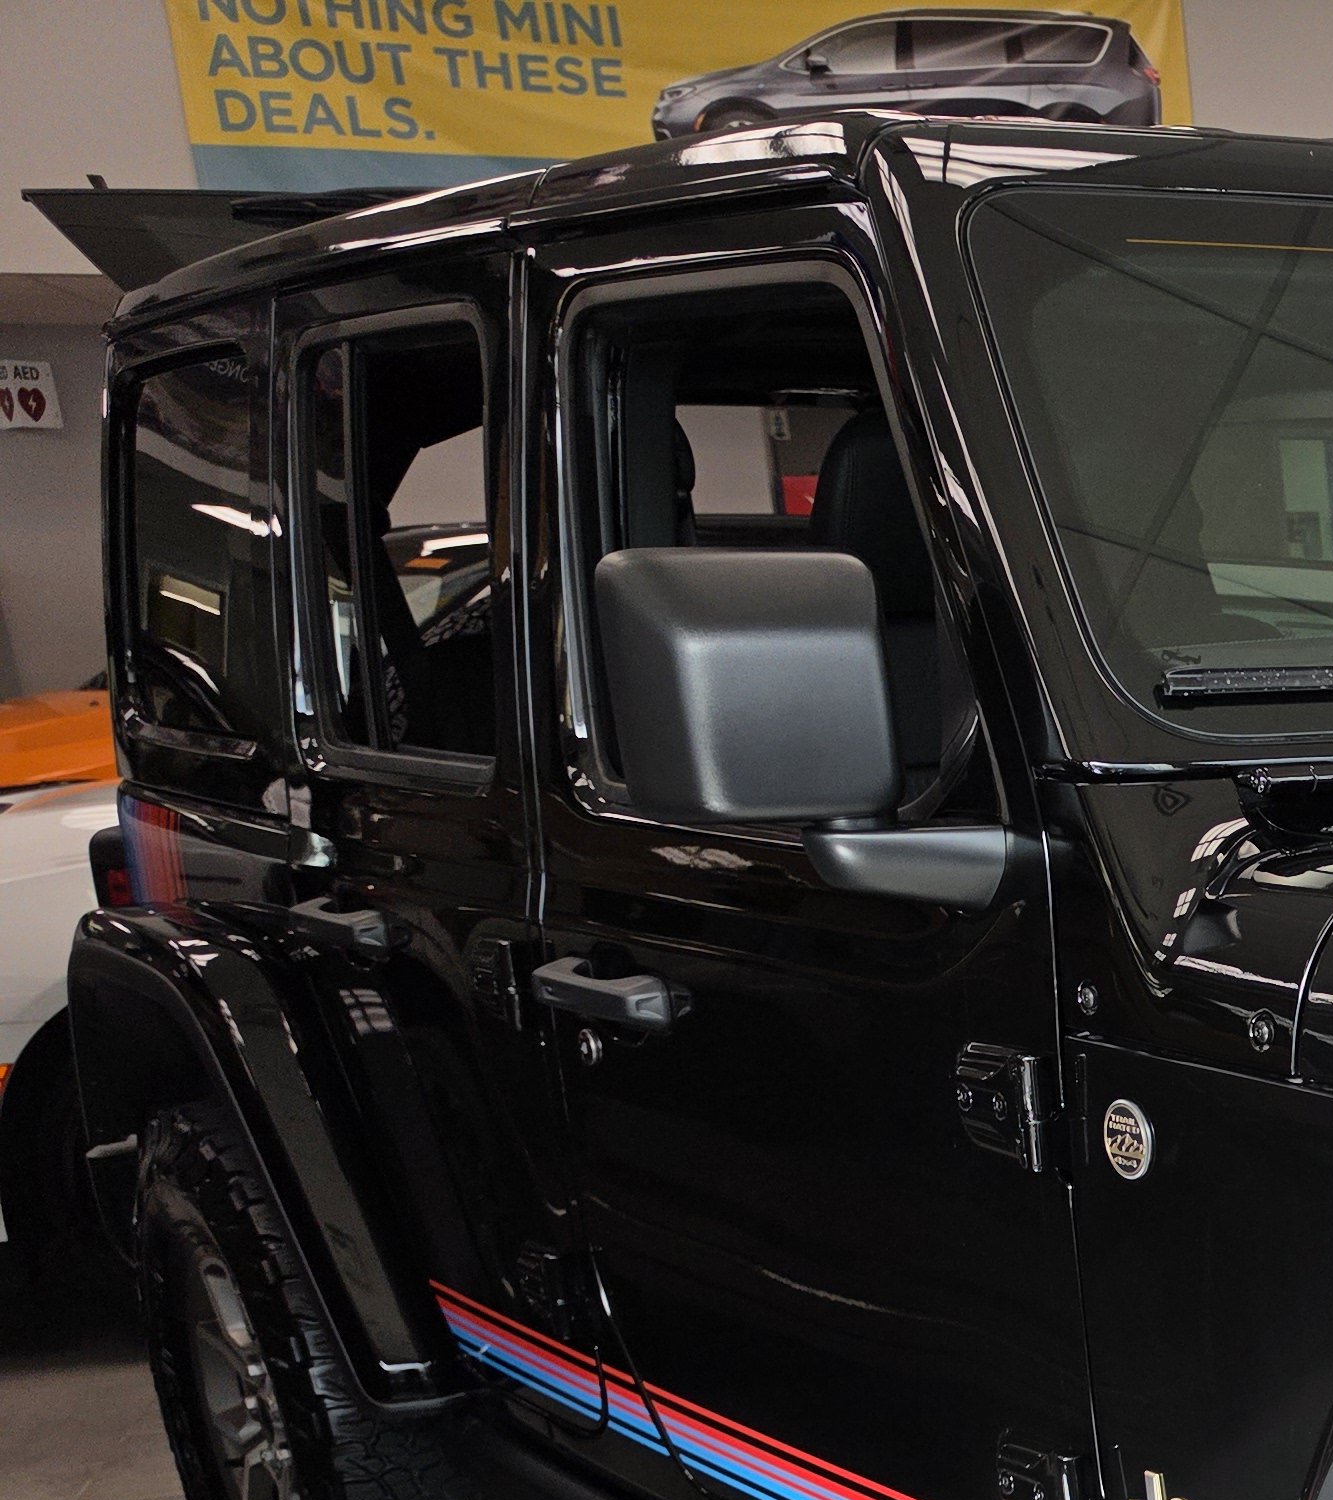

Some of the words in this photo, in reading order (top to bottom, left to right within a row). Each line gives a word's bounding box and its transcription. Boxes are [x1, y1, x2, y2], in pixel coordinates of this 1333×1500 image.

[495, 1, 624, 48] MINI
[208, 33, 411, 86] ABOUT
[433, 46, 627, 98] THESE
[213, 89, 436, 141] DEALS.
[13, 364, 40, 380] AED
[1108, 1120, 1141, 1135] RATED
[1110, 1113, 1137, 1126] TRAIL
